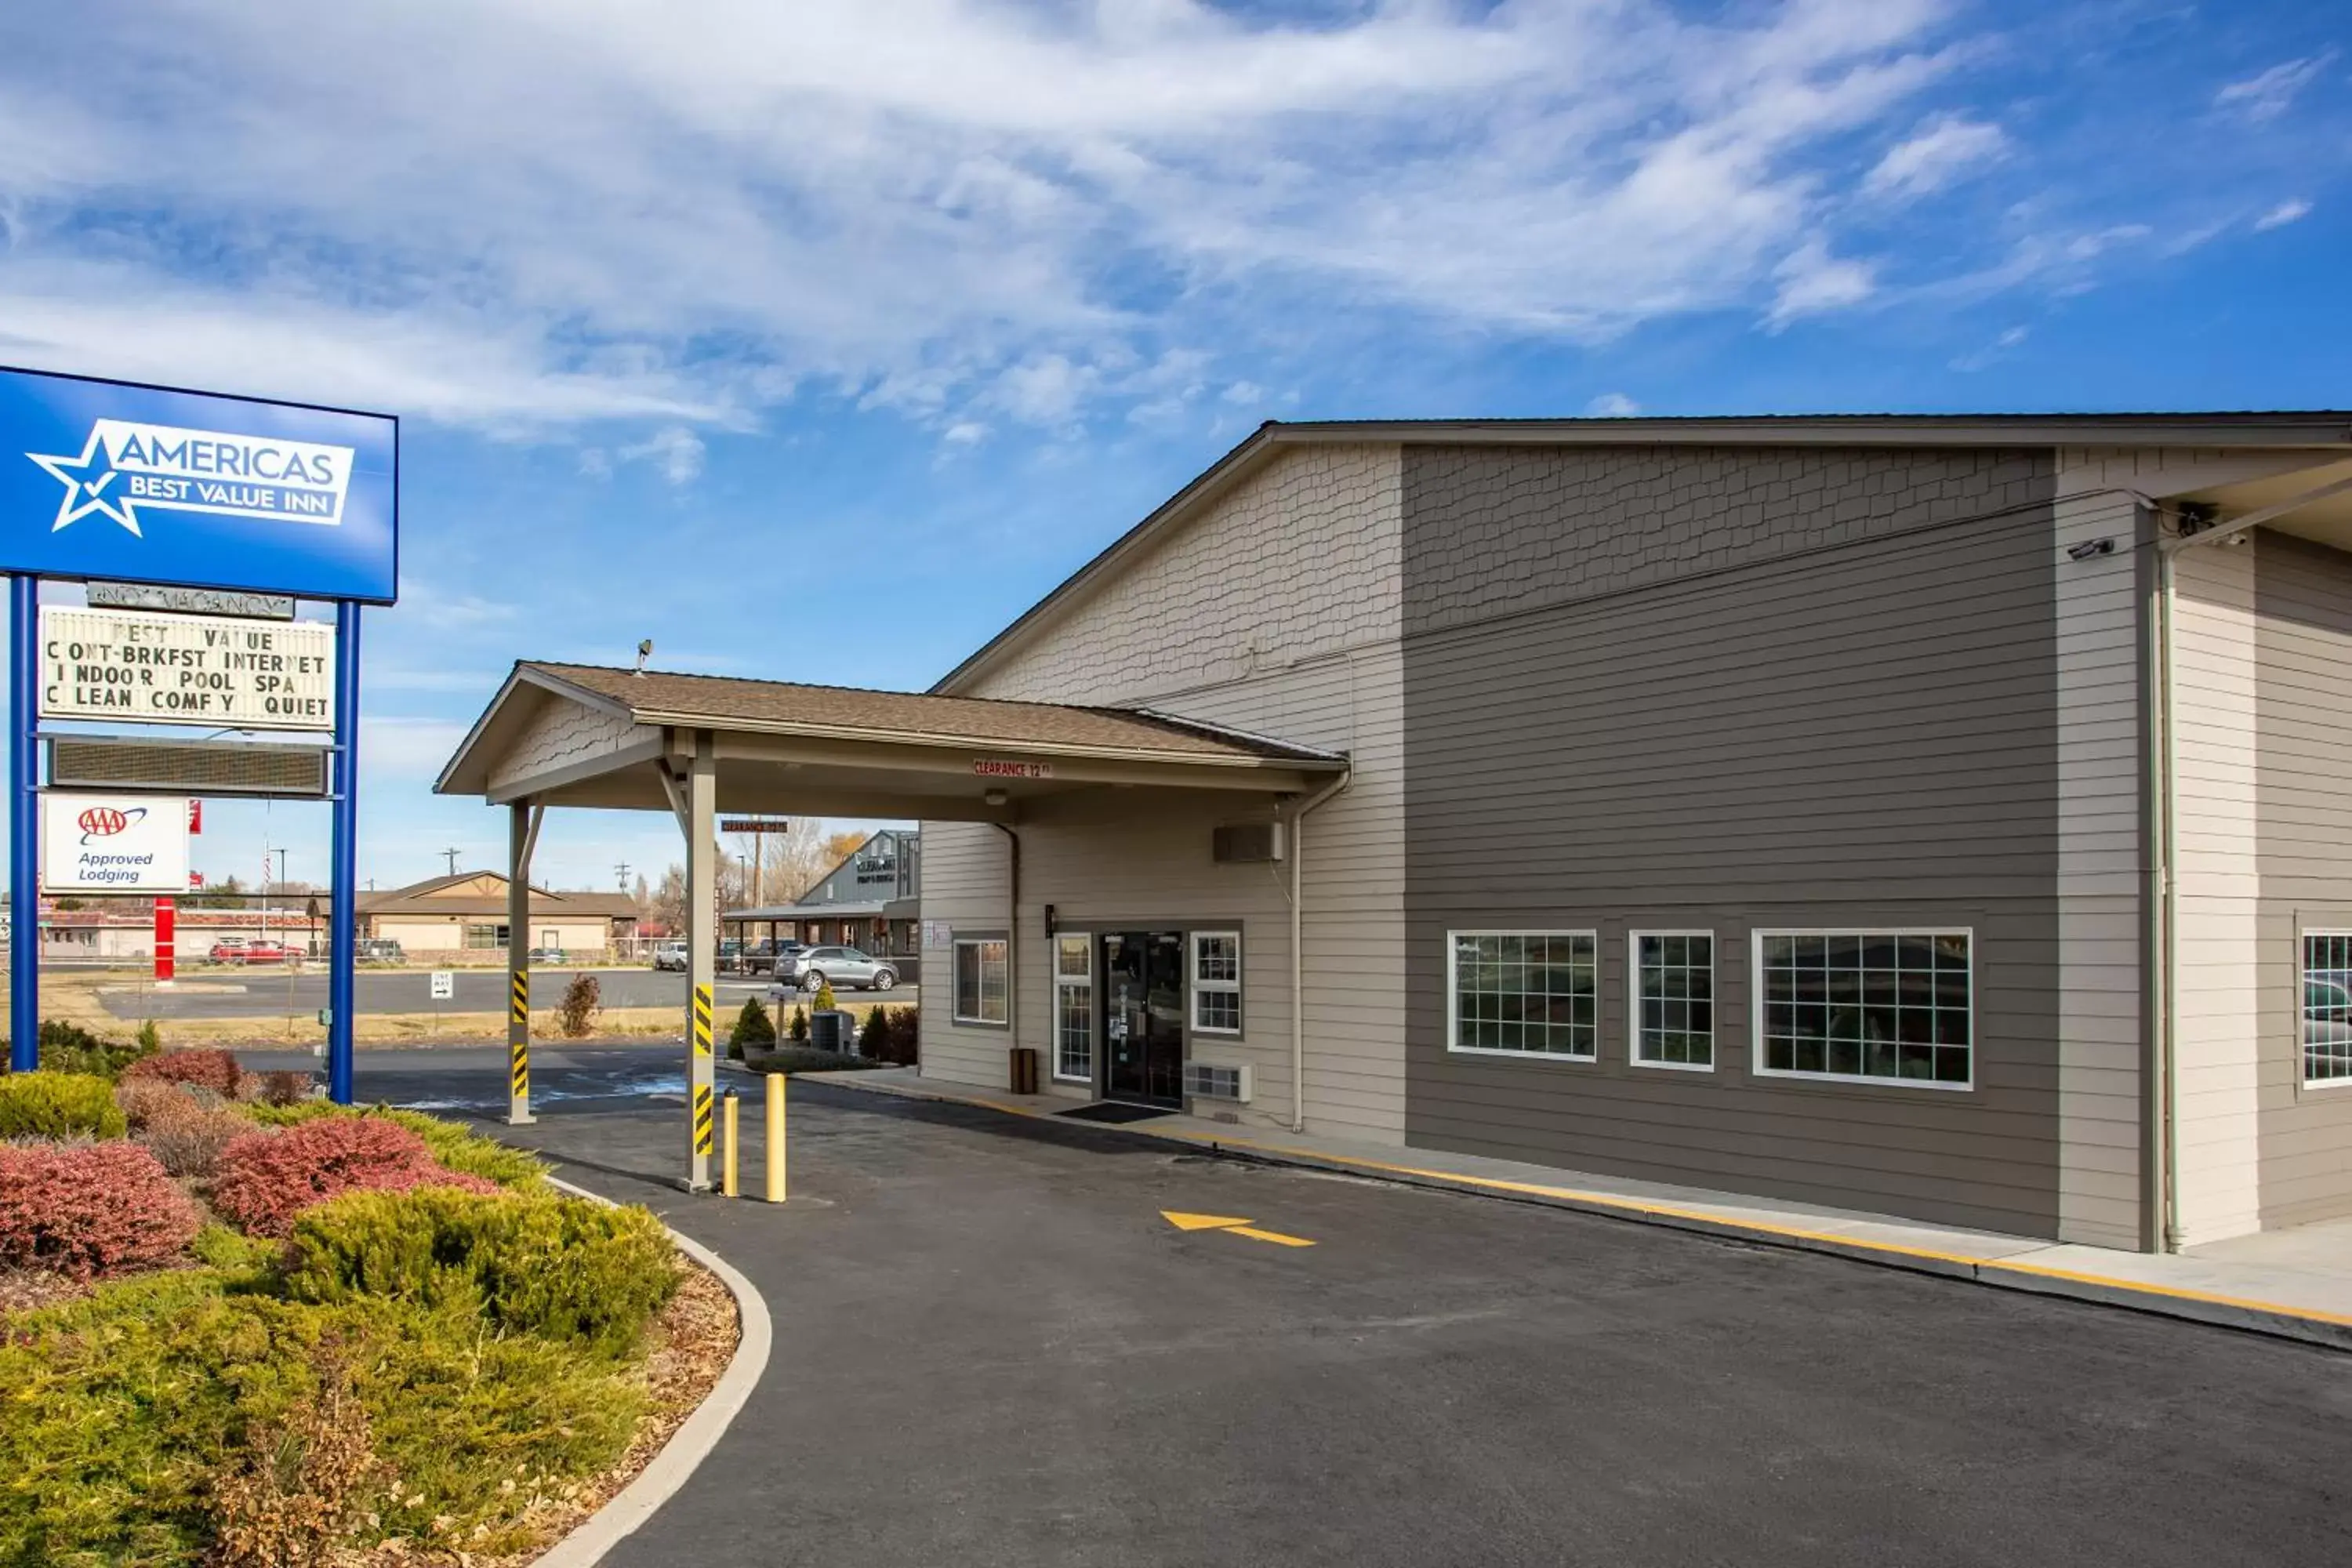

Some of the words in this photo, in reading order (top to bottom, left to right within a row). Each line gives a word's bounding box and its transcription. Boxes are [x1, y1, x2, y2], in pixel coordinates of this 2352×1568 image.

[117, 433, 333, 485] AMERICAS
[130, 476, 192, 499] BEST
[197, 482, 275, 509] VALUE
[285, 492, 328, 514] INN
[99, 586, 142, 605] NO
[160, 590, 283, 616] VACANCY
[57, 664, 154, 686] INDOOR
[180, 670, 235, 691] POOL
[255, 675, 295, 694] SPA
[46, 686, 132, 706] CLEAN
[264, 697, 328, 716] QUIET
[975, 760, 1025, 775] CLEARANCE
[1029, 764, 1040, 777] 12
[81, 808, 124, 835] AAA
[78, 852, 154, 867] Approved
[78, 868, 140, 884] Lodging
